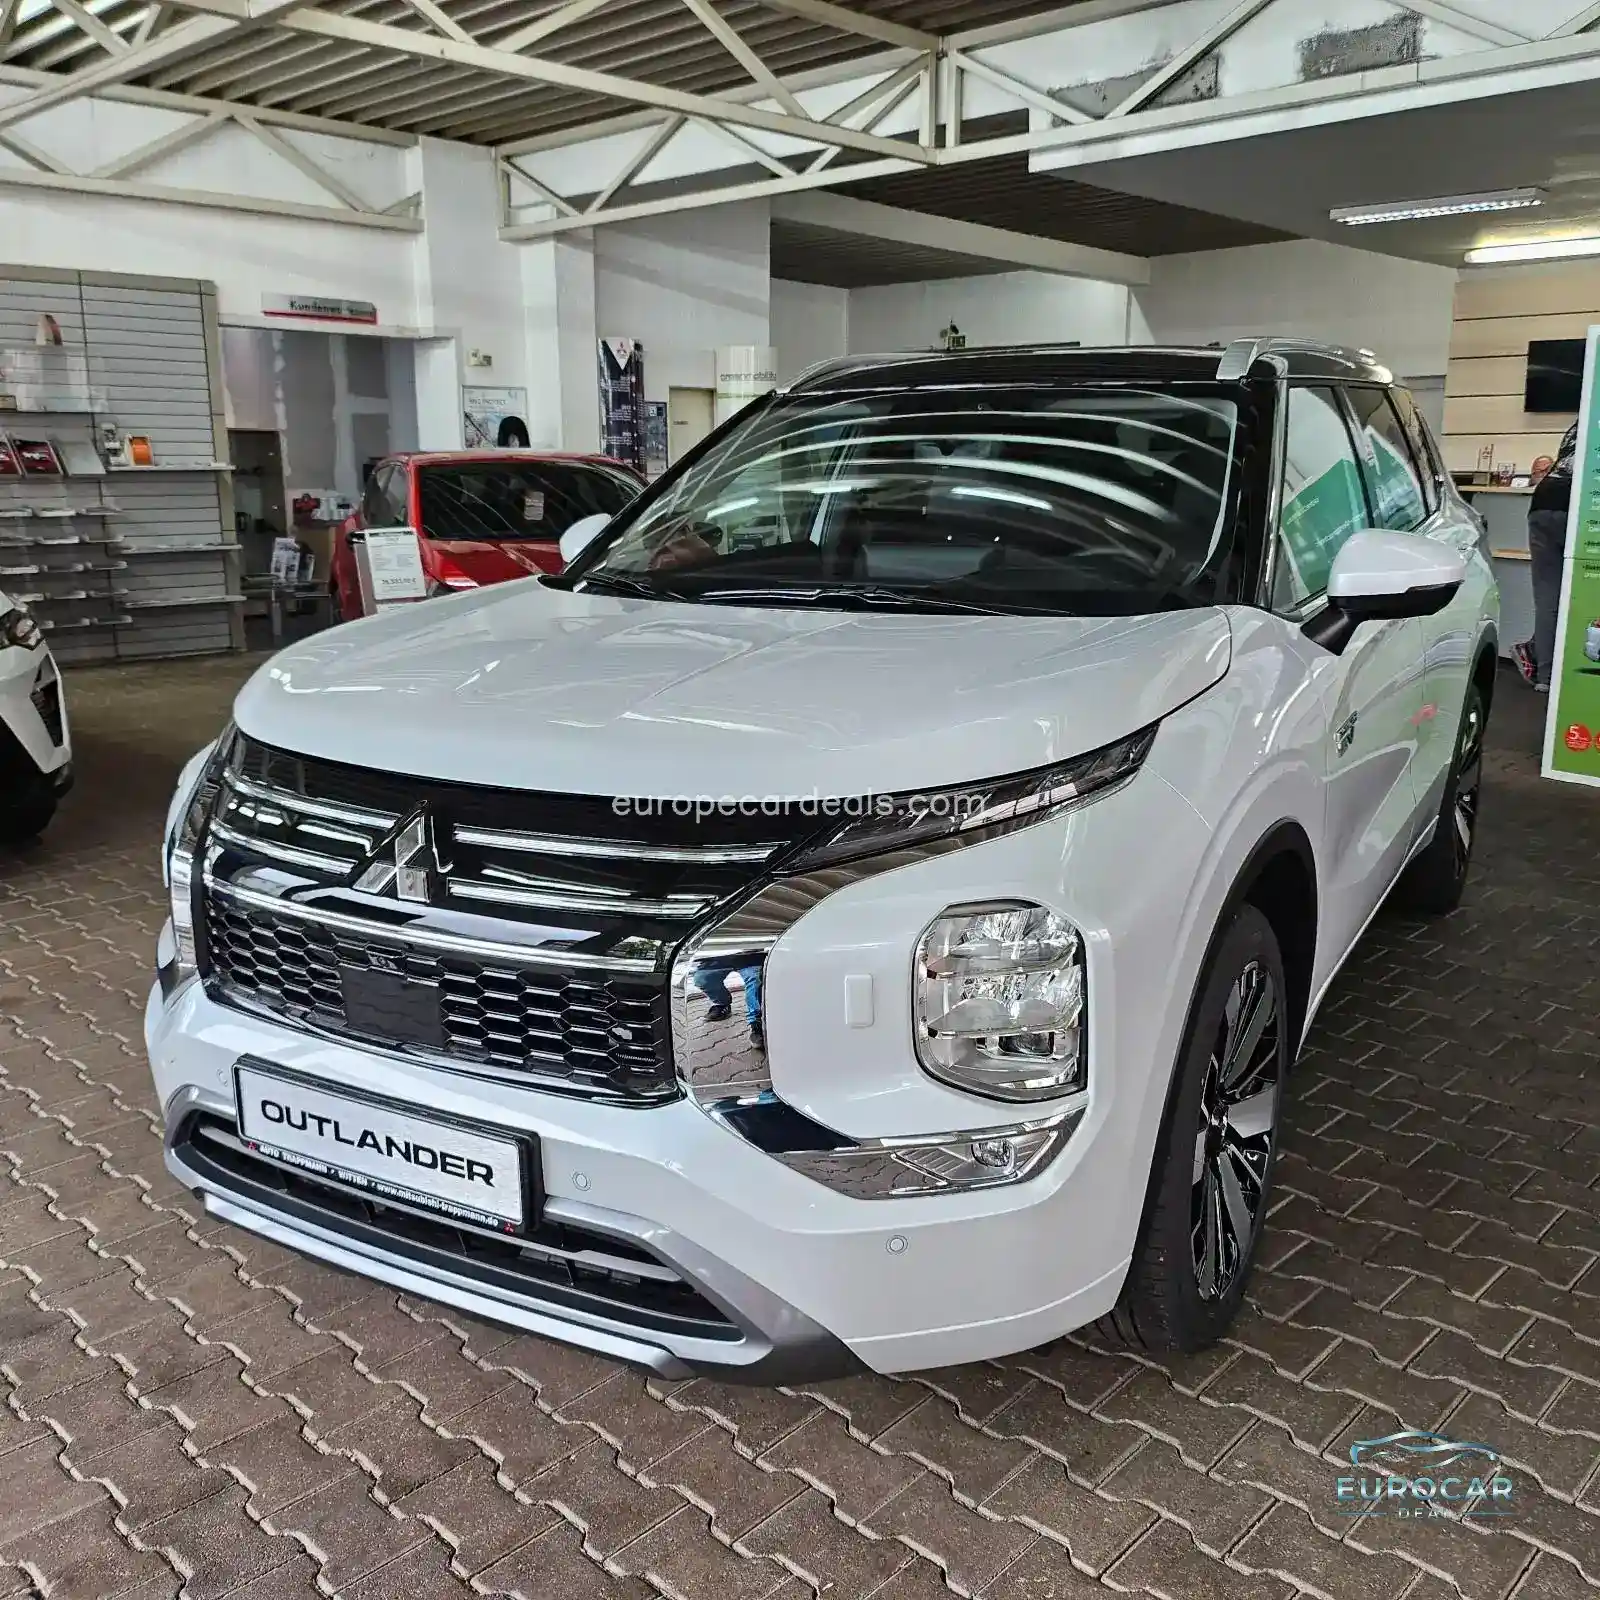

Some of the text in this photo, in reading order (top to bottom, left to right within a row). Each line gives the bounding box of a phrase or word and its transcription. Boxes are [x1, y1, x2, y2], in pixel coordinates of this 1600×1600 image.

[260, 1144, 280, 1158] AUTO
[281, 1151, 328, 1175] TRAPPMANN
[261, 1099, 495, 1188] OUTLANDER
